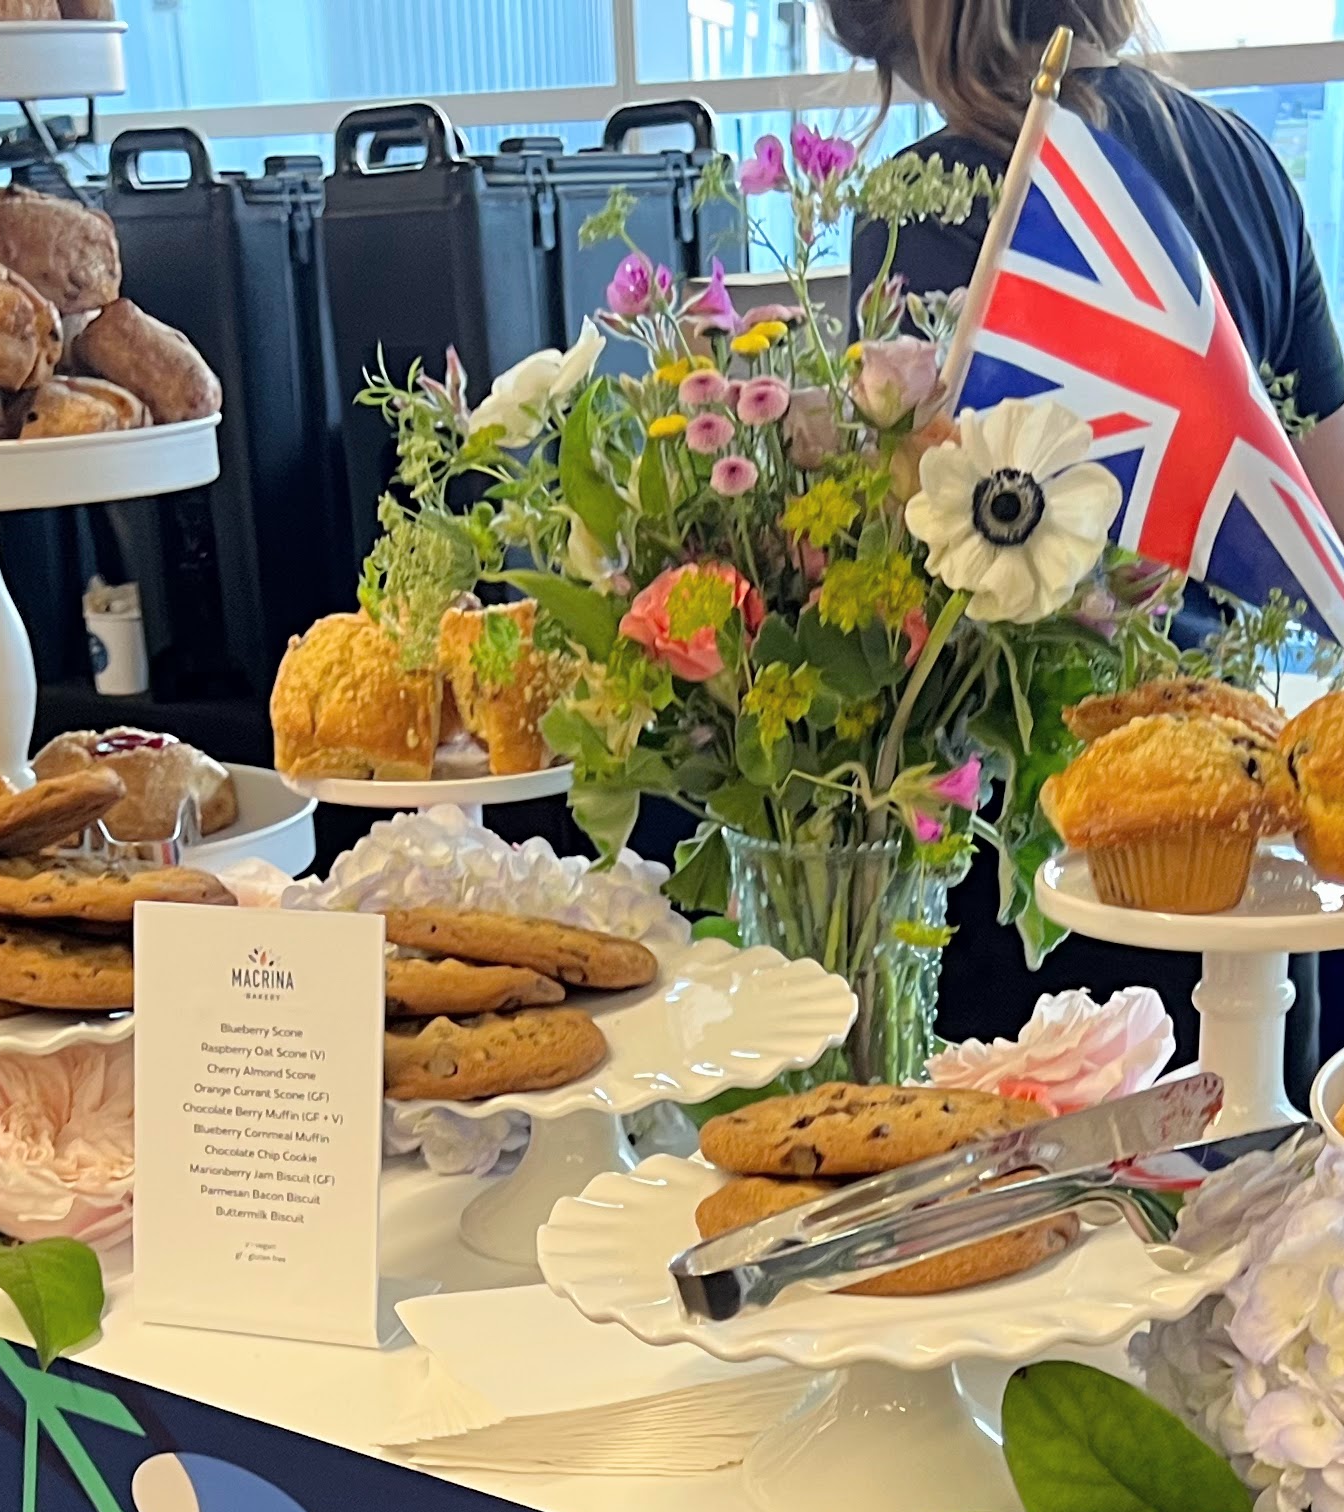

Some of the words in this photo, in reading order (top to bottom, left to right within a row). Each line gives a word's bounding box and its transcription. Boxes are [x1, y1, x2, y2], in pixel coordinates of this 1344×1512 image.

[231, 967, 295, 991] MACRINA
[245, 992, 281, 1002] BAKERY
[220, 1022, 270, 1039] Blueberry
[271, 1025, 304, 1038] Scone
[200, 1041, 253, 1060] Raspberry
[254, 1045, 274, 1058] Oat
[276, 1046, 308, 1059] Scone
[309, 1049, 326, 1062] (V)
[206, 1062, 241, 1079] Cherry
[242, 1065, 284, 1079] Almond
[285, 1068, 317, 1081] Scone
[193, 1082, 232, 1098] Orange
[233, 1085, 272, 1099] Currant
[273, 1088, 306, 1101] Scone
[307, 1090, 330, 1104] (GF)
[182, 1102, 233, 1116] Chocolate
[235, 1105, 264, 1122] Berry
[265, 1108, 300, 1121] Muffin
[301, 1110, 320, 1125] (GF
[331, 1113, 344, 1126] V)
[193, 1123, 243, 1140] Blueberry
[244, 1126, 293, 1142] Cornmeal
[295, 1131, 330, 1144] Muffin
[204, 1144, 255, 1159] Chocolate
[256, 1148, 281, 1163] Chip
[282, 1150, 318, 1164] Cookie
[189, 1163, 252, 1182] Marionberry
[253, 1169, 275, 1181] Jam
[276, 1170, 311, 1184] Biscuit
[312, 1173, 336, 1187] (GF)
[200, 1183, 251, 1199] Parmesan
[252, 1188, 285, 1202] Bacon
[286, 1191, 321, 1206] Biscuit
[215, 1205, 268, 1220] Buttermilk
[270, 1210, 305, 1224] Biscuit
